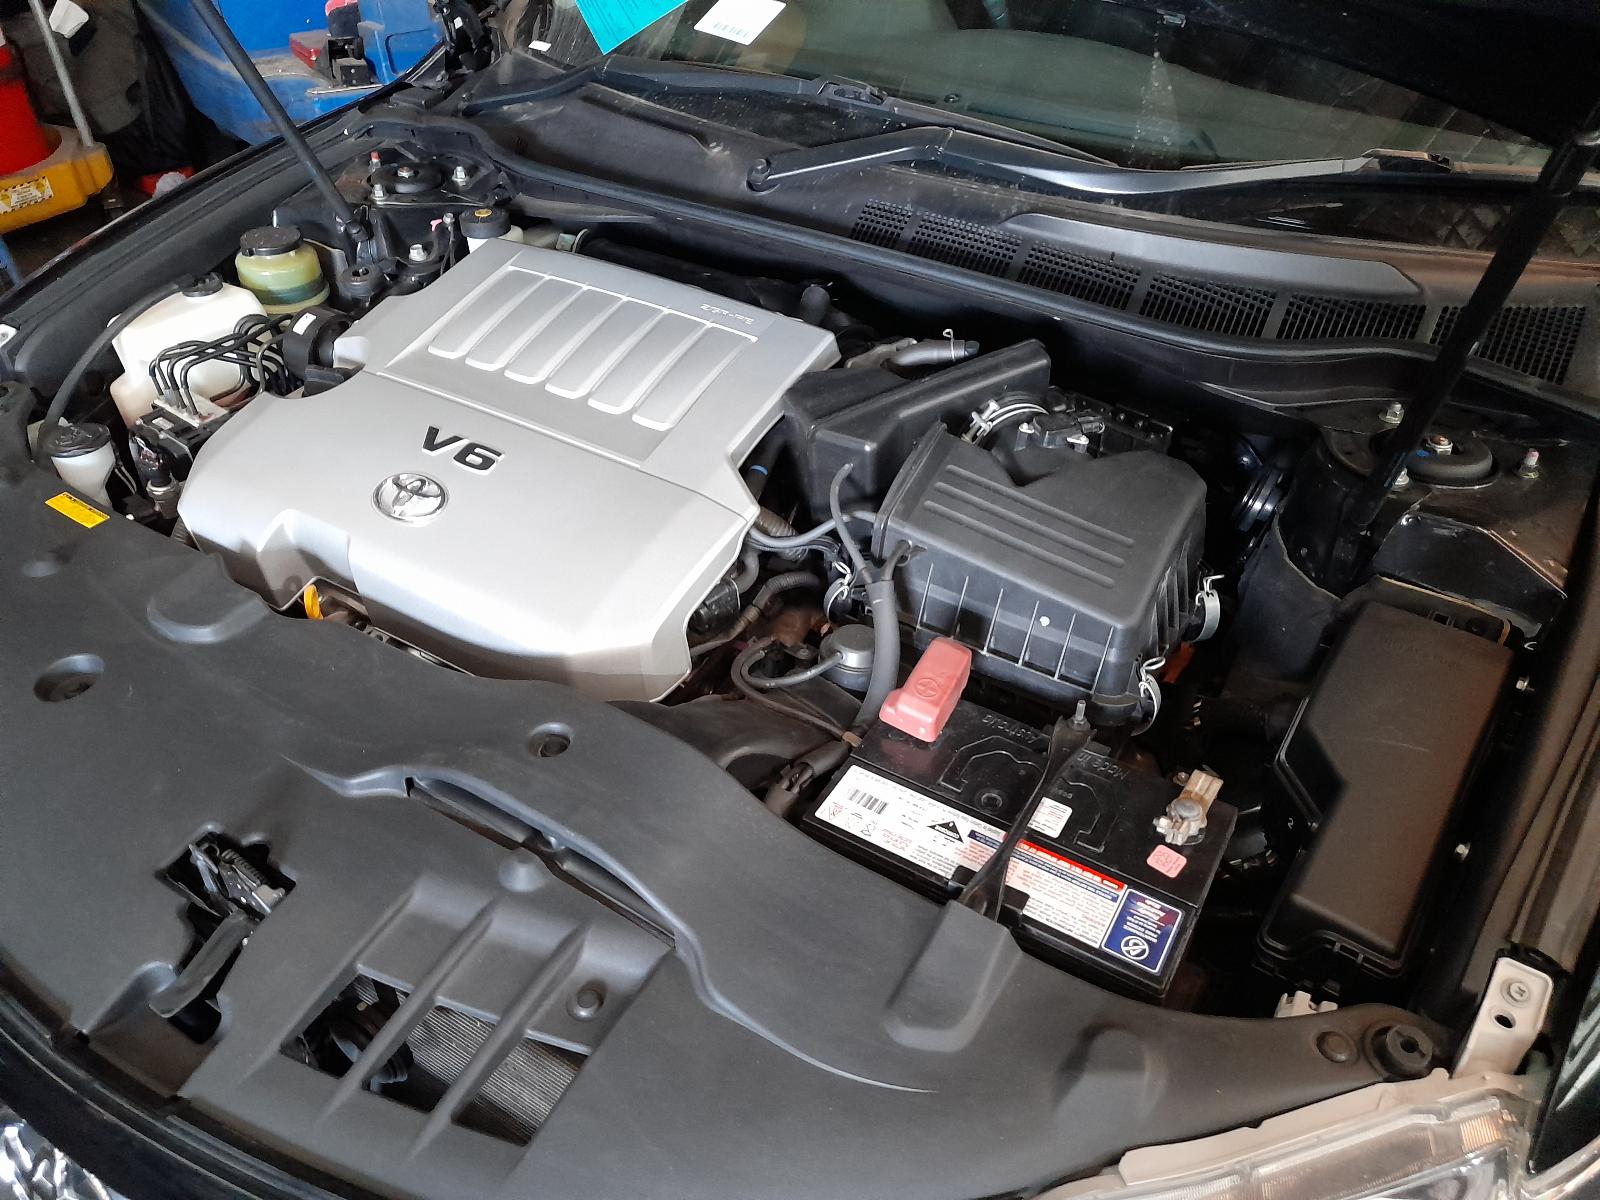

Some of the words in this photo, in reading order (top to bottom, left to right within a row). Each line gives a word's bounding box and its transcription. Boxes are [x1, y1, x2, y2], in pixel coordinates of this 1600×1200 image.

[422, 425, 504, 475] V6
[981, 714, 1042, 745] Australia
[1092, 759, 1129, 780] Made
